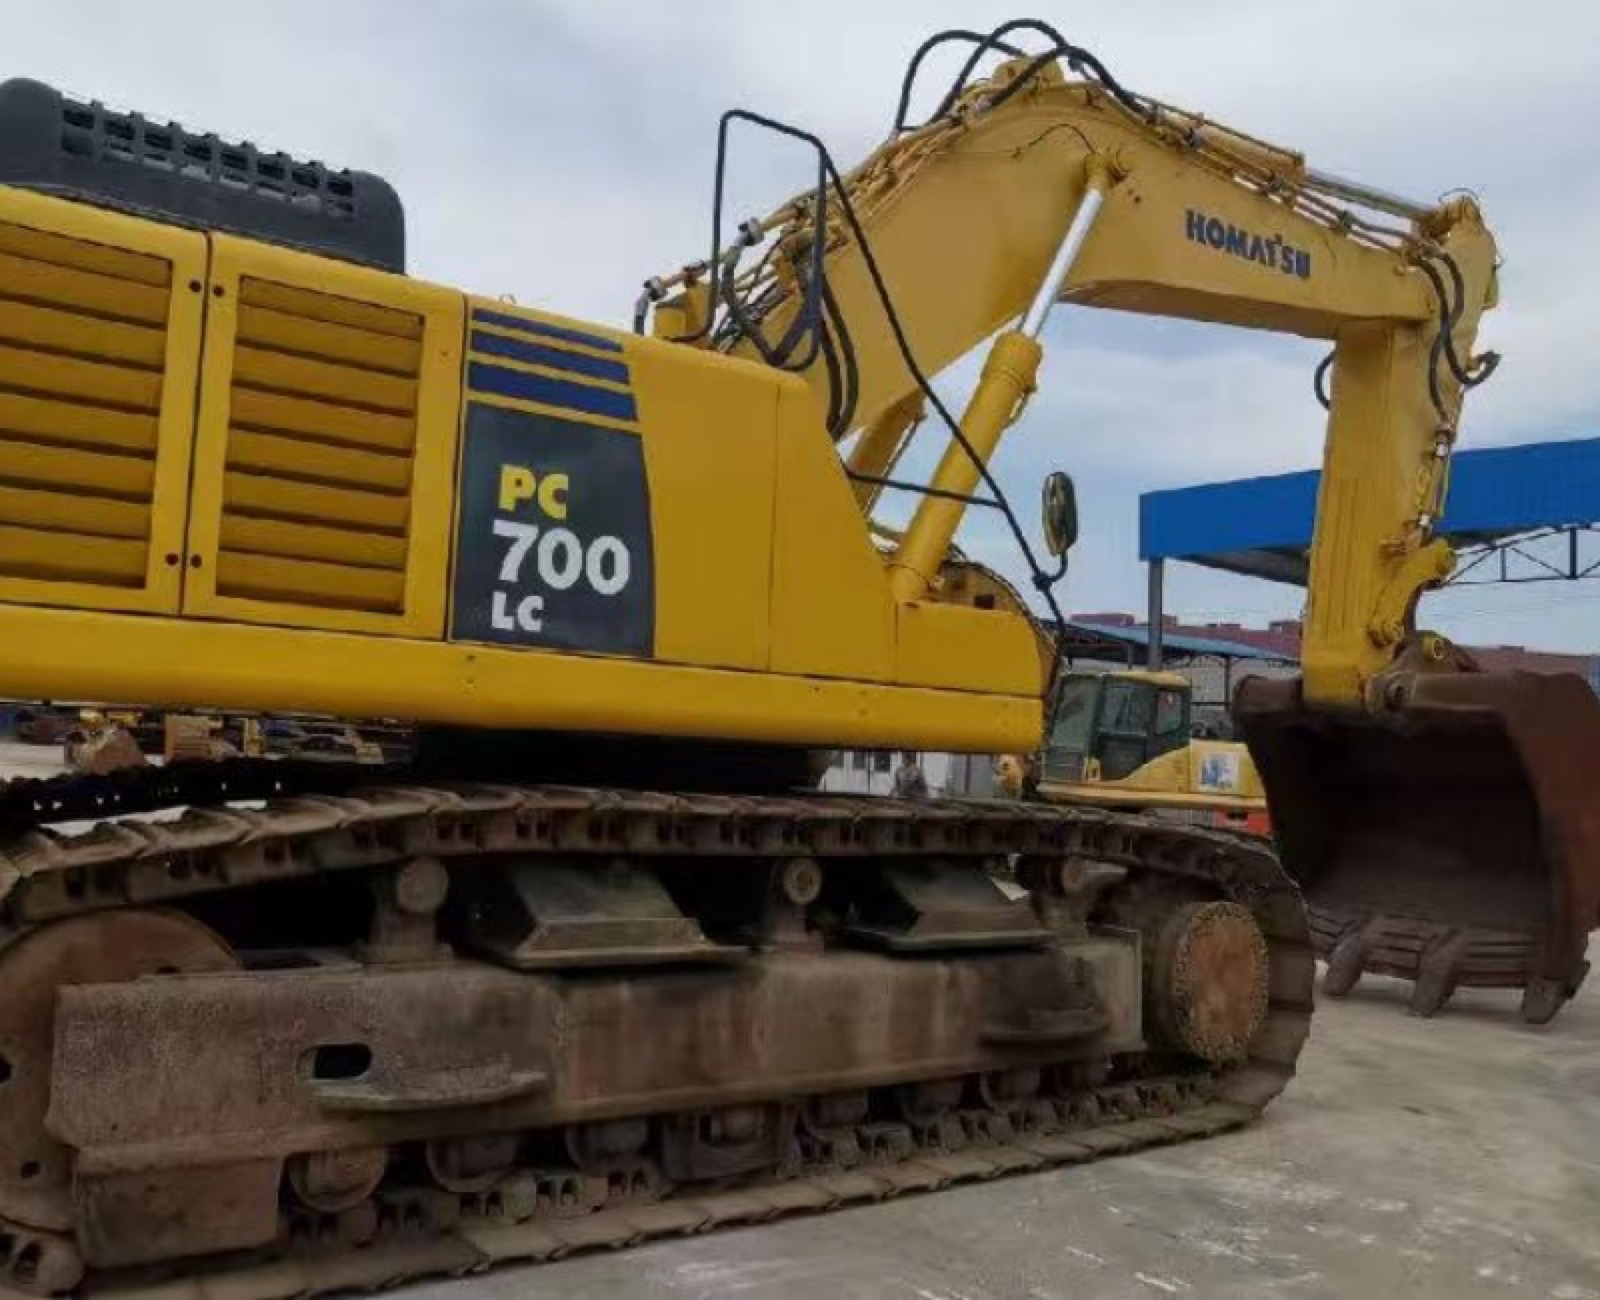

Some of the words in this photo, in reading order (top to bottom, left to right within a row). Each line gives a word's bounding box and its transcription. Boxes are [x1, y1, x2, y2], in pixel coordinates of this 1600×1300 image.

[499, 464, 569, 519] PC
[492, 519, 631, 596] 700
[491, 590, 545, 633] LC
